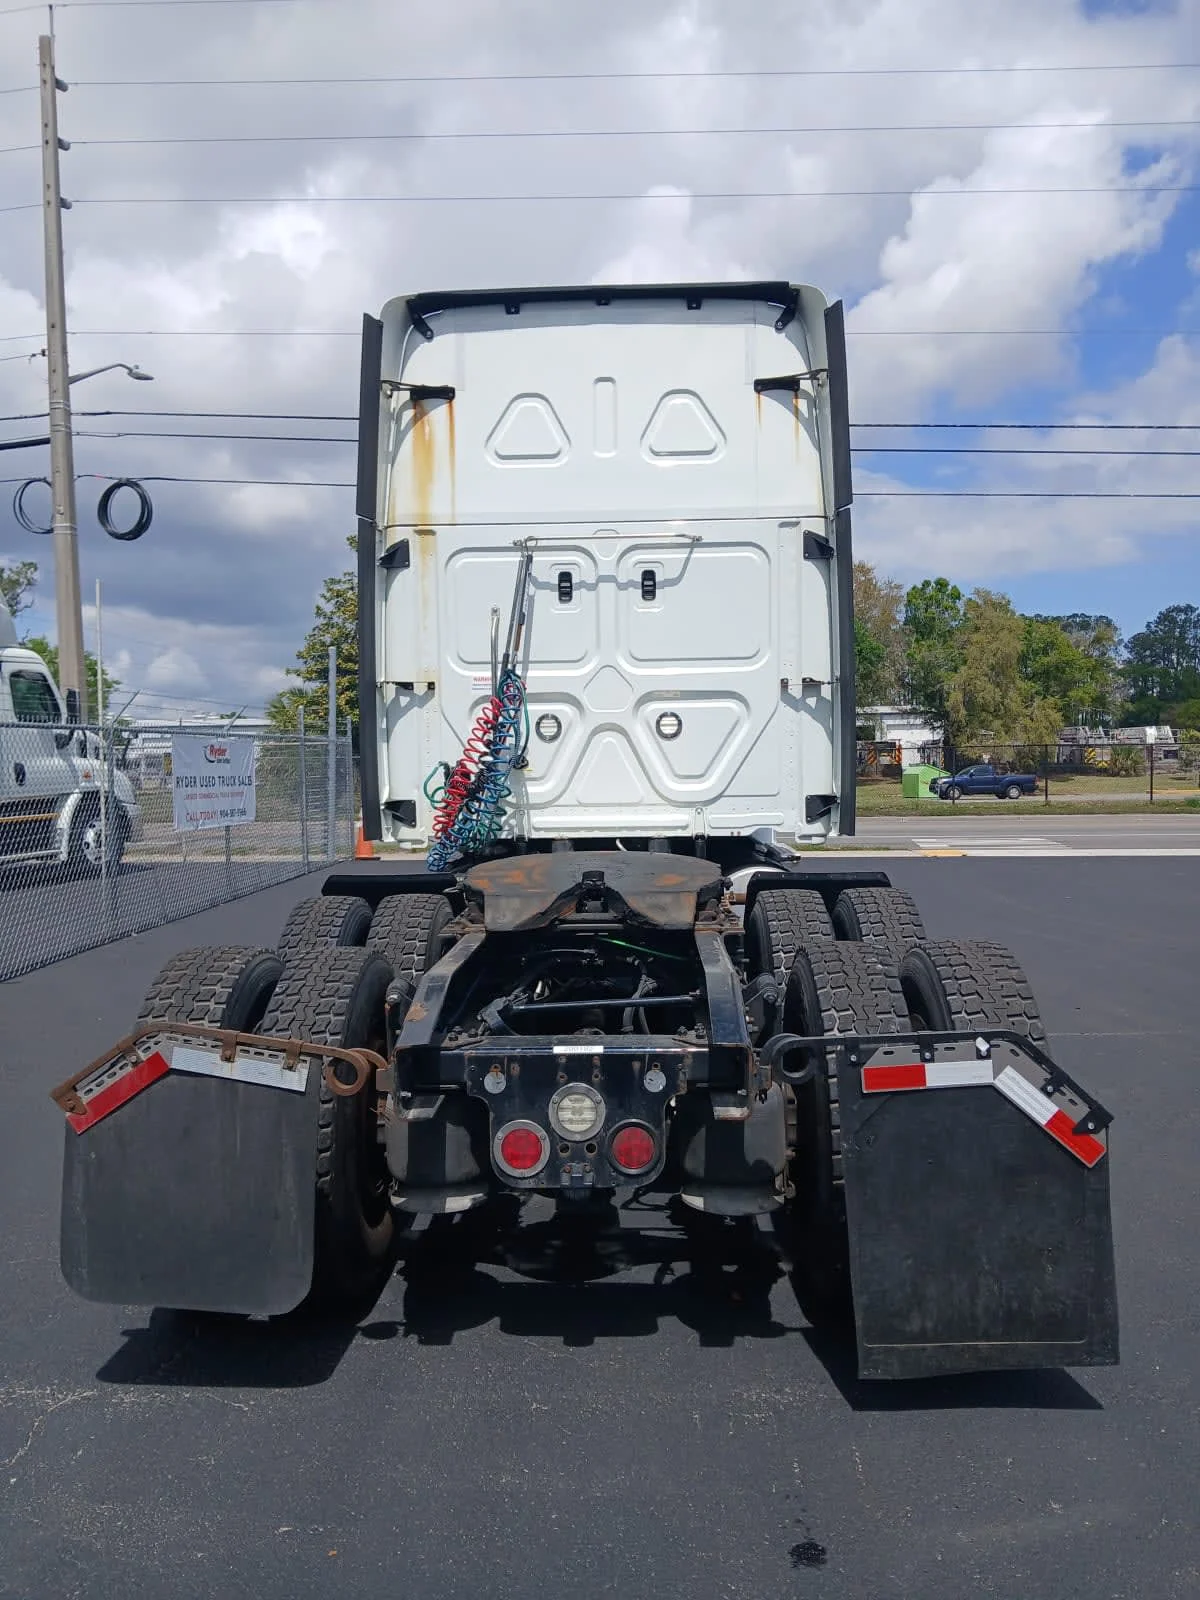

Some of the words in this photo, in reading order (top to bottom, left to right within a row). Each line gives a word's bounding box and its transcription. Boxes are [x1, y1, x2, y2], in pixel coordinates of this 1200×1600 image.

[209, 744, 227, 759] Ryder
[176, 775, 197, 788] RYDER
[200, 775, 216, 788] USED
[218, 775, 237, 788] TRUCK
[186, 811, 200, 822] CALL
